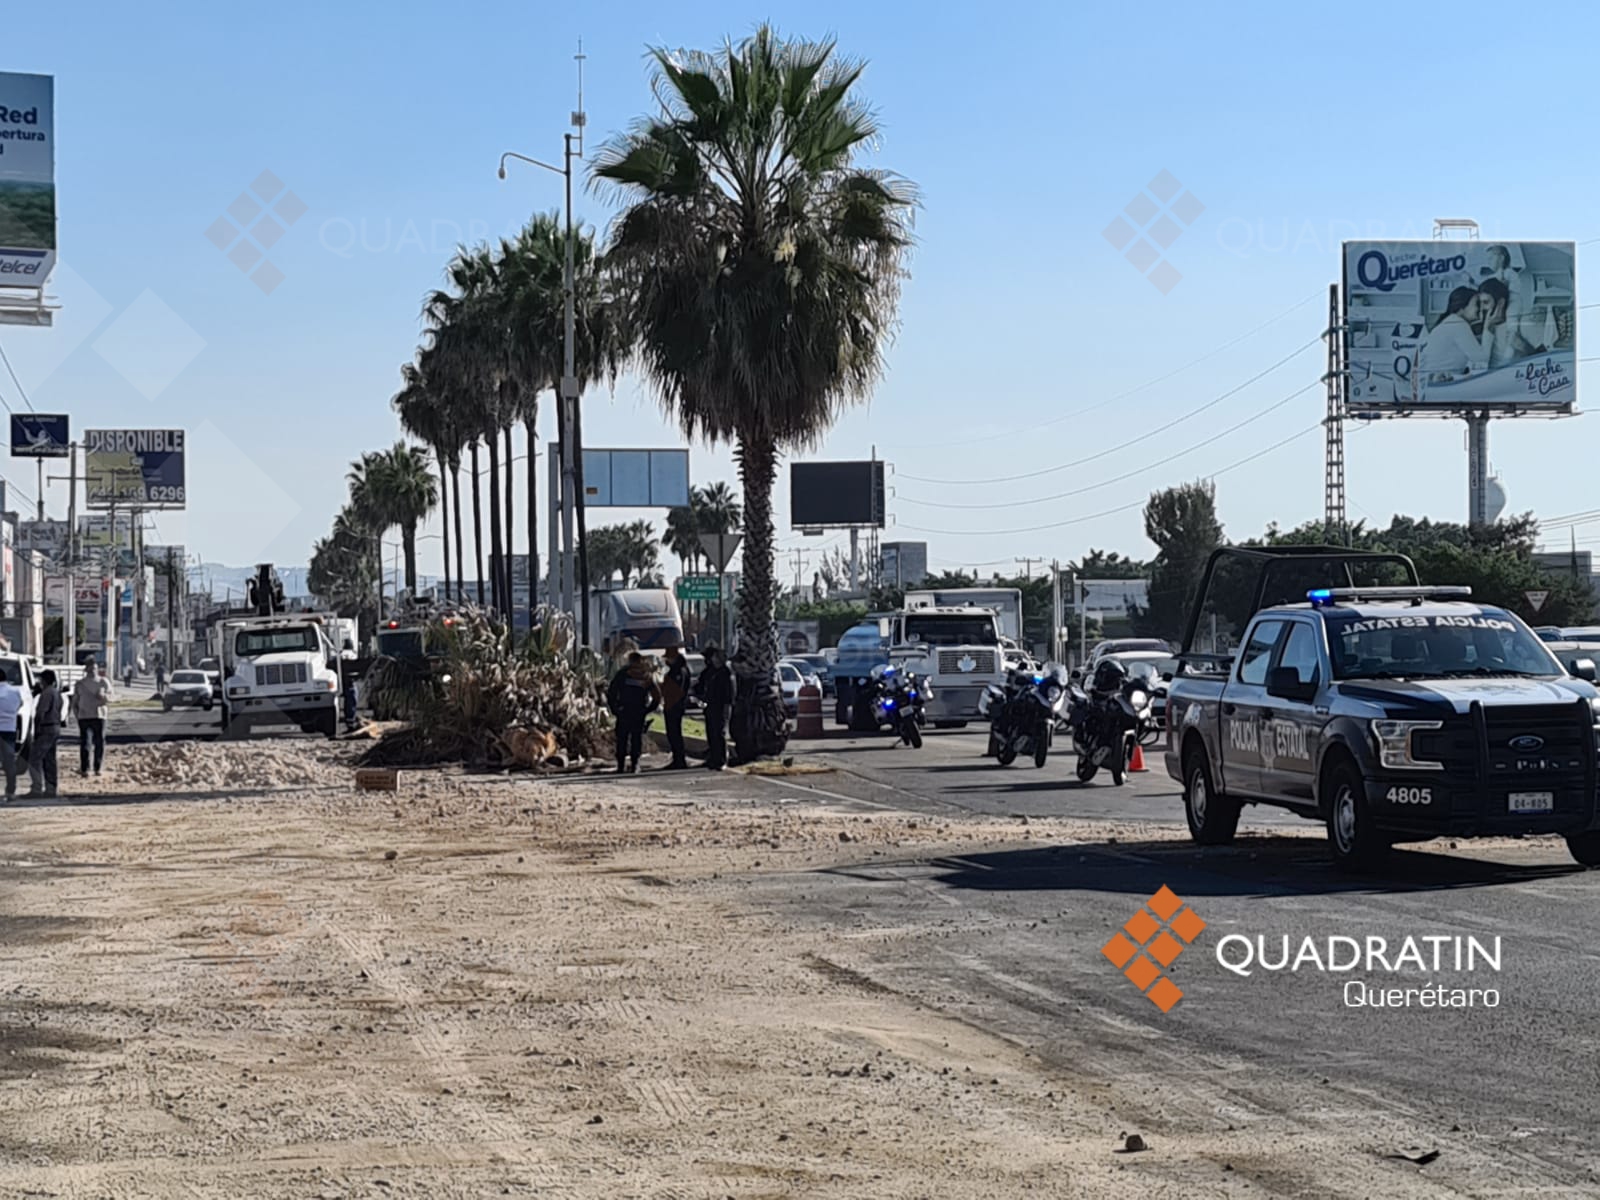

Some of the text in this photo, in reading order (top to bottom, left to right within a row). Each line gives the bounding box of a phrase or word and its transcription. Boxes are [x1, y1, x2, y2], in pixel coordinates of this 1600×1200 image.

[0, 129, 46, 141] ertura
[0, 258, 42, 275] elcel
[1357, 249, 1466, 291] Querétaro
[90, 431, 183, 452] DISPONIBLE
[150, 486, 185, 501] 6296
[1276, 725, 1310, 760] ESTATAL
[1386, 787, 1432, 805] 4805
